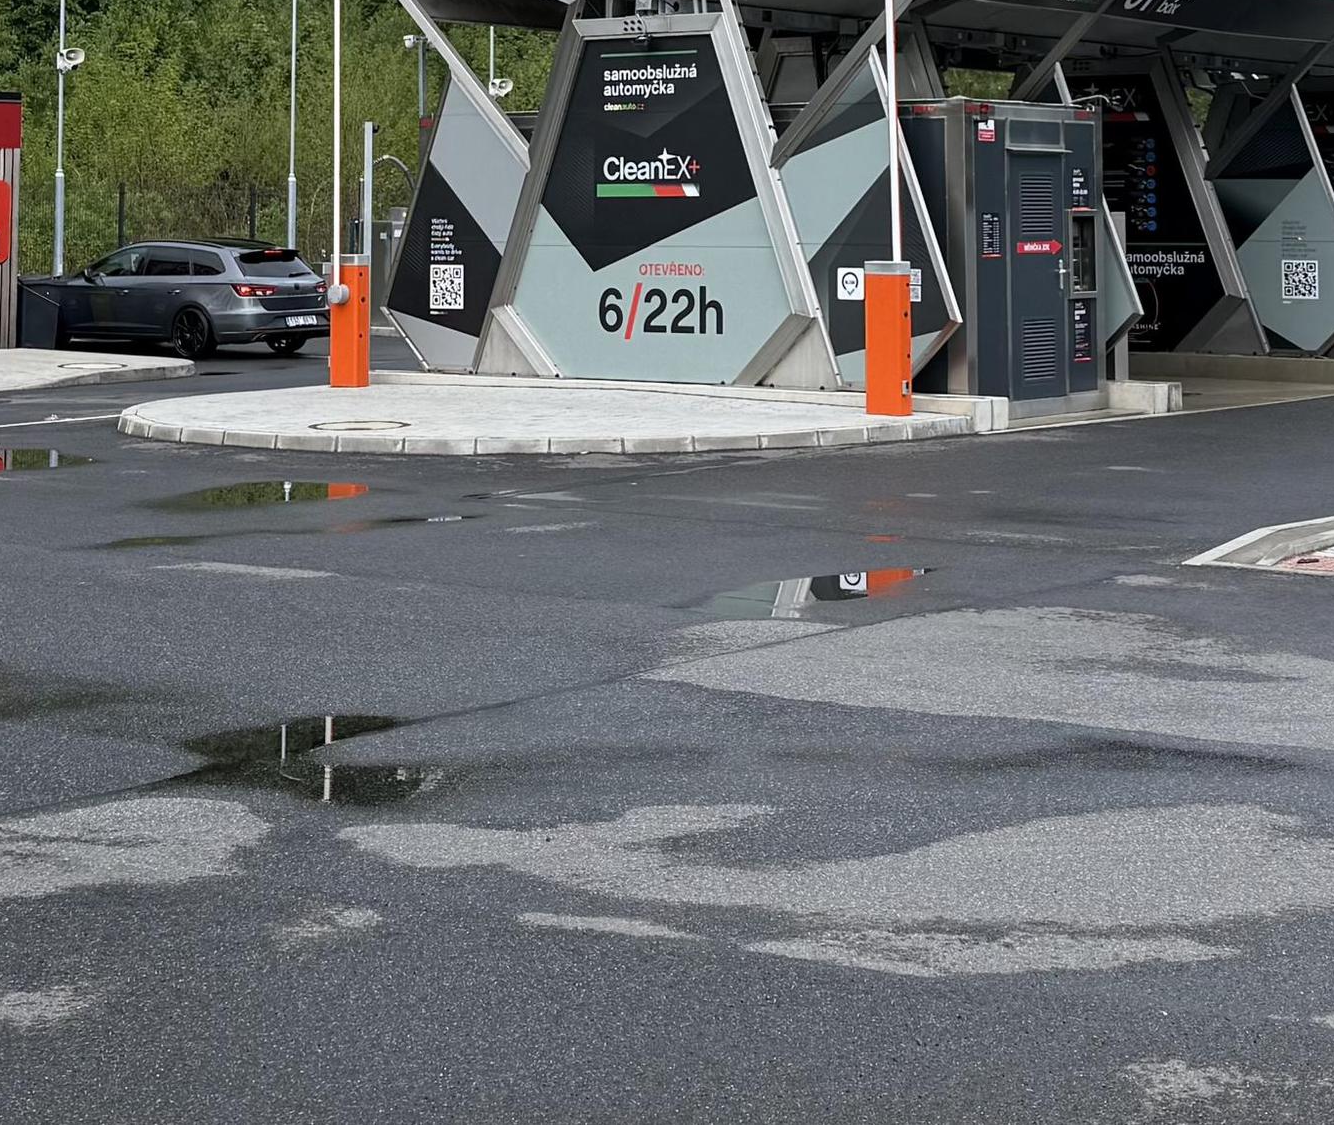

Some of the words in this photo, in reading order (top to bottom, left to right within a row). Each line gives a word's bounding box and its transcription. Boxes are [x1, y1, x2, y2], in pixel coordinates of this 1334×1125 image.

[603, 63, 697, 81] samoobslužná
[603, 80, 675, 99] automyčka
[1126, 251, 1205, 263] amoobslužná
[639, 261, 705, 276] OTEVŘENO:
[1129, 263, 1185, 278] tomyčka
[599, 282, 724, 340] 6/22h
